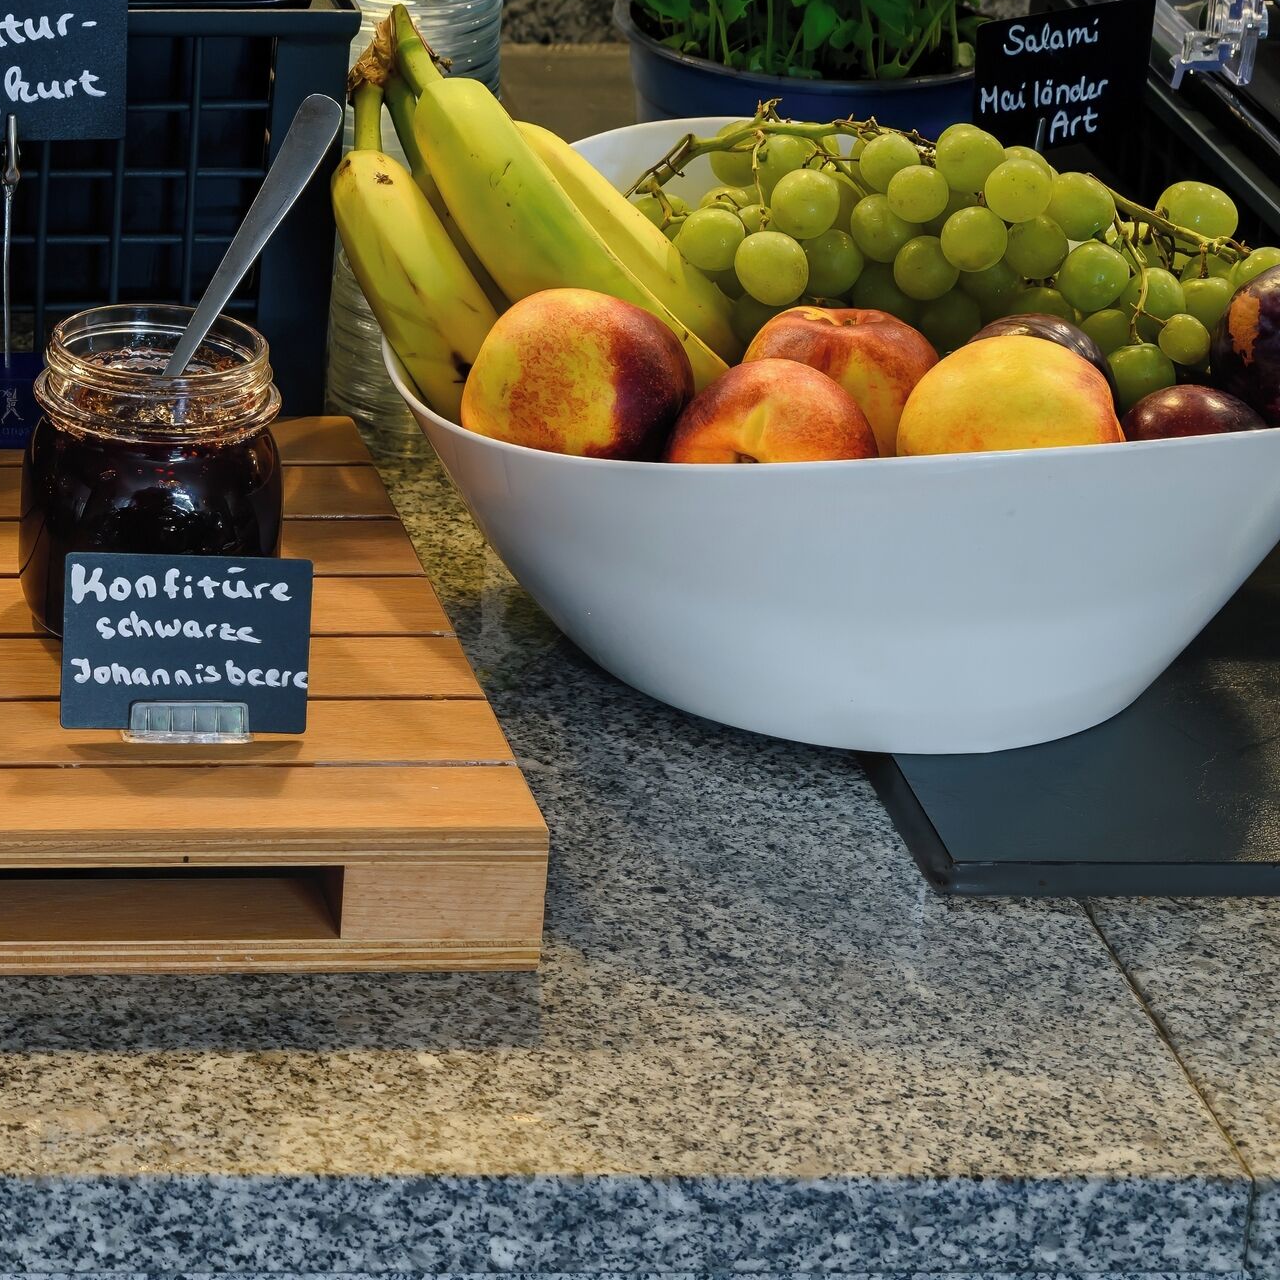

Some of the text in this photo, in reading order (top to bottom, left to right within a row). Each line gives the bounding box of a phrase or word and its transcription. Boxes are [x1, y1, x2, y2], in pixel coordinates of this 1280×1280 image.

[1003, 18, 1099, 56] Salami
[1050, 106, 1099, 143] Art
[71, 562, 293, 604] Konfitüre
